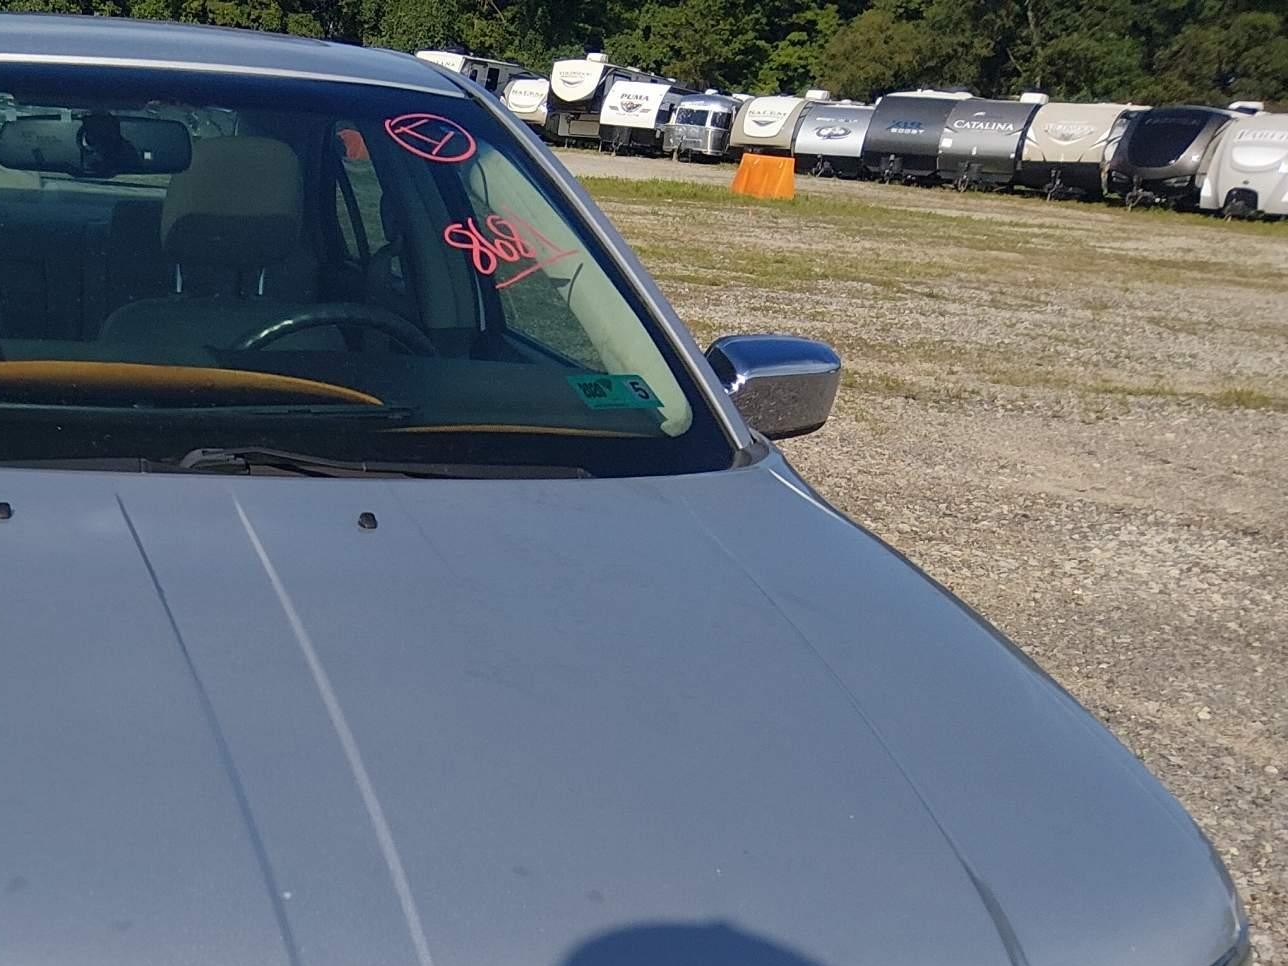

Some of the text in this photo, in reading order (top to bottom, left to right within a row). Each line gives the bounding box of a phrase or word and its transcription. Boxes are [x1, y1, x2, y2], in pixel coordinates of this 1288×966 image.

[620, 93, 649, 102] PUMA
[953, 119, 1014, 131] CATALINA
[629, 381, 650, 400] 5
